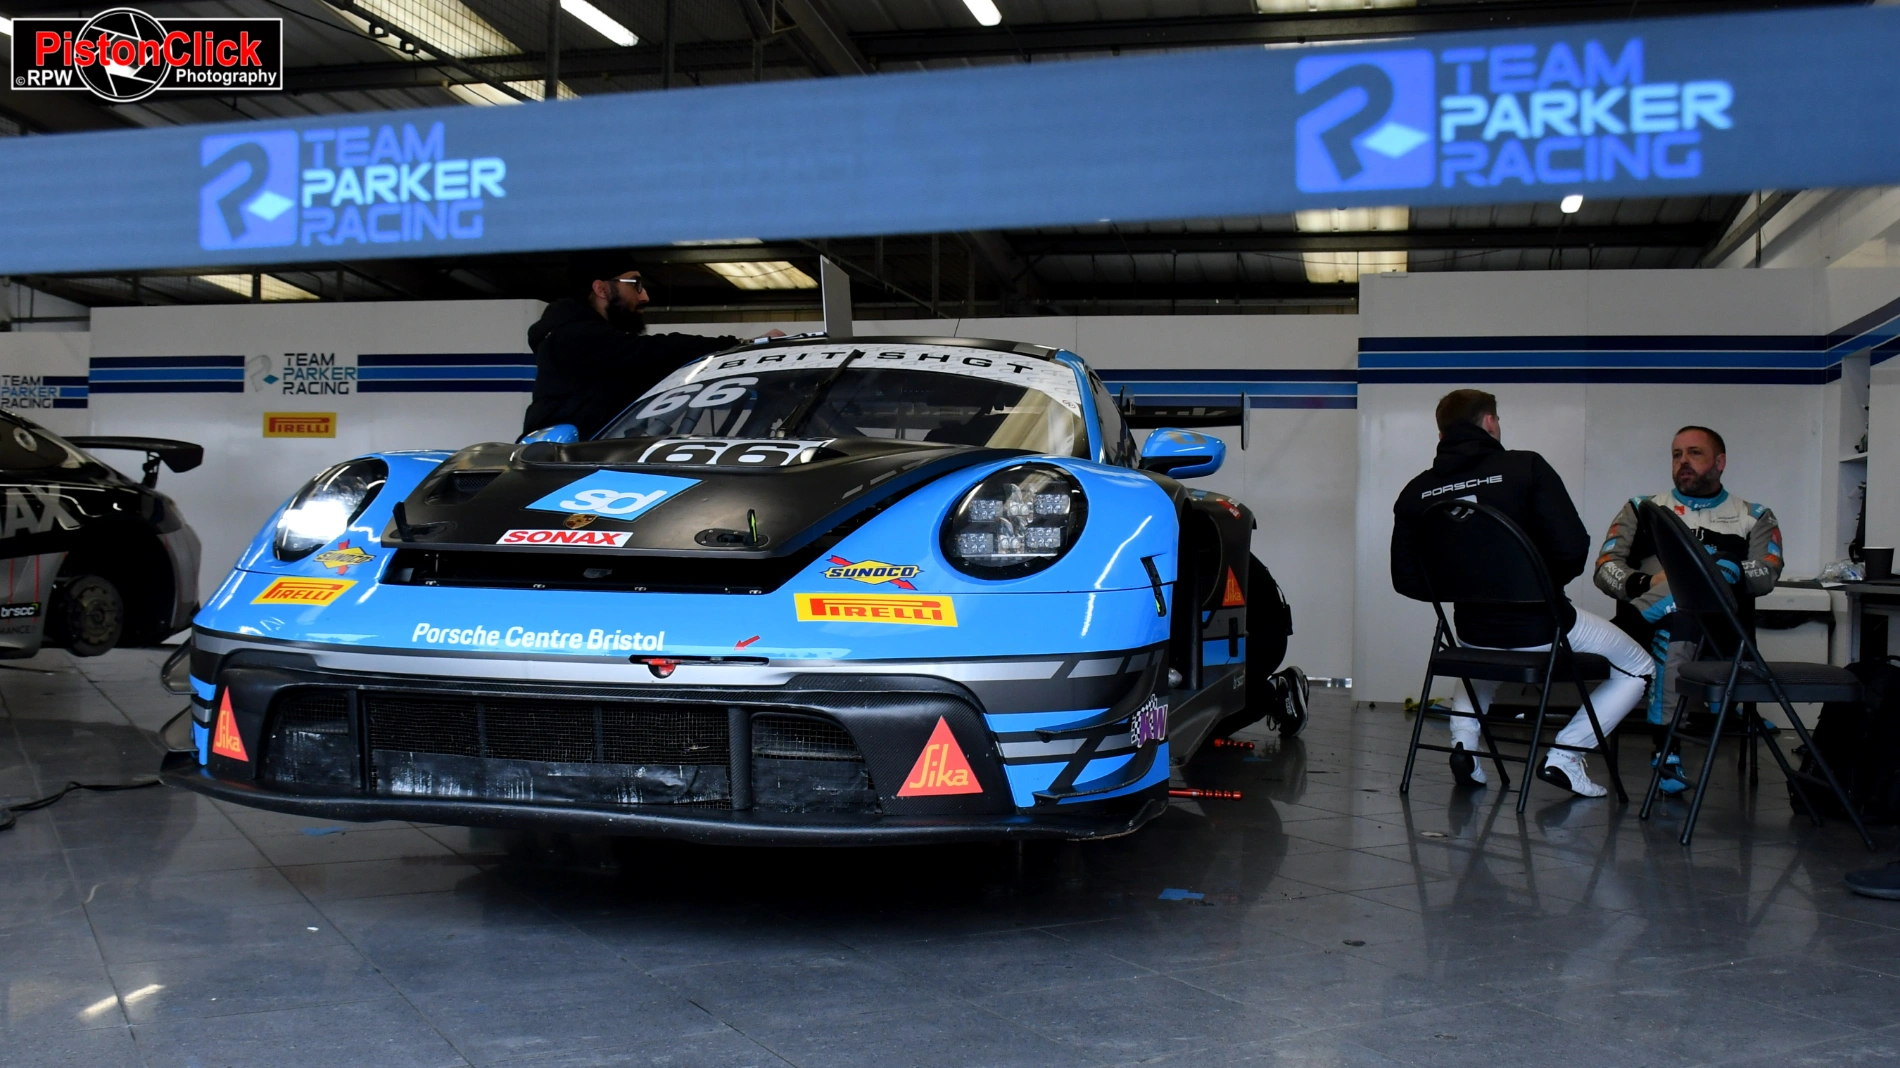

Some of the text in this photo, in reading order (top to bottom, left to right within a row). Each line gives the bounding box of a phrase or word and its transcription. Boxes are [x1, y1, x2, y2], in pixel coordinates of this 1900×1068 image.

[1440, 36, 1645, 96] TEAM
[1440, 80, 1734, 142] PARKER
[302, 121, 445, 169] TEAM
[1440, 131, 1702, 189] RACING
[301, 158, 507, 207] PARKER
[301, 201, 485, 247] RACING
[283, 353, 335, 366] TEAM
[2, 375, 41, 387] TEAM
[282, 366, 357, 380] PARKER
[1, 387, 58, 398] PARKER
[281, 381, 350, 395] RACING
[636, 376, 759, 420] 66
[1, 398, 52, 409] RACING
[269, 417, 331, 434] PIRELLI
[644, 441, 801, 465] 66
[1421, 474, 1503, 499] PORSCHE
[504, 531, 622, 546] SONAX
[315, 551, 372, 564] SUNOCO
[829, 564, 920, 579] SUNOCO
[261, 581, 344, 601] PIRELLI
[1225, 579, 1242, 603] Sika
[810, 598, 943, 621] PIRELLI
[412, 623, 665, 651] Porsche Centre Bristol
[215, 711, 242, 752] Sika
[909, 743, 970, 790] Sika
